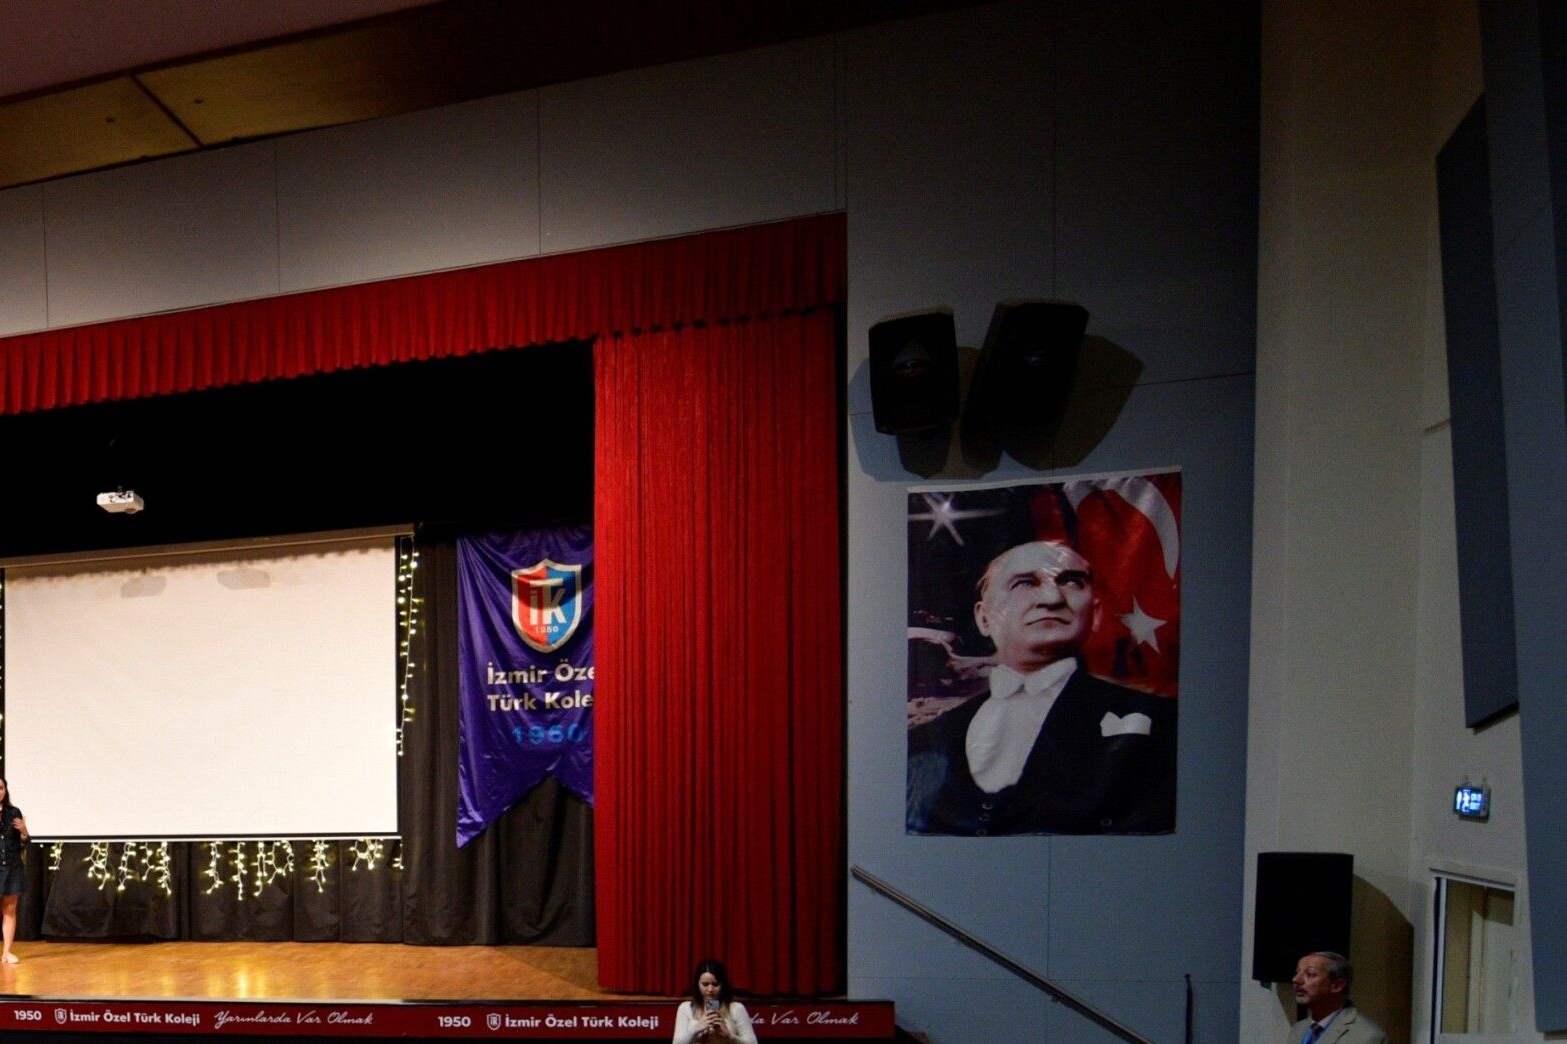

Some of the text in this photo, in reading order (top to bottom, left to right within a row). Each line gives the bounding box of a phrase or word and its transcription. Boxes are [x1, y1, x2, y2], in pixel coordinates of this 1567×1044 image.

[487, 658, 594, 685] İzmir Öze
[487, 689, 593, 711] Türk Kole
[14, 1010, 42, 1020] 1950
[70, 1009, 99, 1022] İzmir
[103, 1009, 131, 1023] Özel
[134, 1012, 161, 1023] Türk
[165, 1013, 200, 1027] Koleji
[296, 1010, 322, 1024] Var
[327, 1011, 373, 1025] Olmak
[438, 1016, 472, 1028] 1950
[505, 1014, 541, 1028] İzmir
[545, 1013, 577, 1028] Özel
[581, 1015, 614, 1028] Türk
[618, 1015, 659, 1031] Koleji
[771, 1010, 800, 1025] Var
[806, 1011, 859, 1025] Olmak
